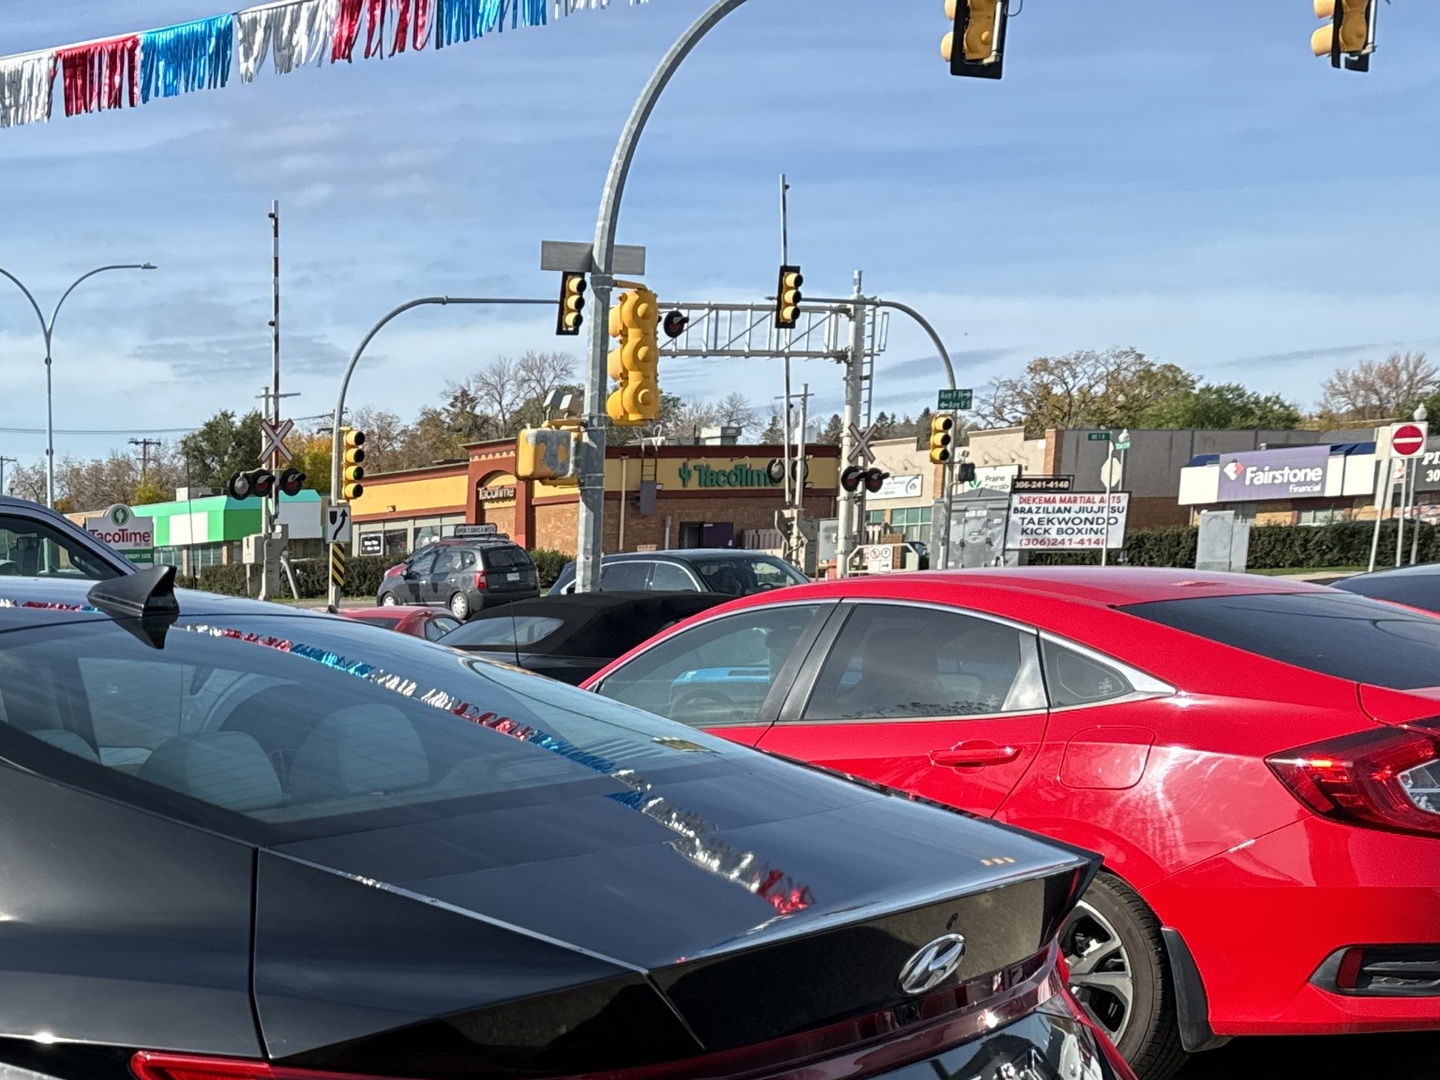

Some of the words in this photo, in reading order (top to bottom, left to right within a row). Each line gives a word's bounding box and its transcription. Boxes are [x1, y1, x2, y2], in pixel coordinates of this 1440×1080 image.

[694, 463, 779, 488] TacoTim
[1245, 465, 1323, 486] Fairstone
[1014, 480, 1069, 489] 306-241-4148
[1288, 482, 1322, 493] Financial
[1018, 496, 1057, 505] DIEKEMA
[1059, 496, 1097, 504] MARTIAL
[1098, 495, 1121, 504] ATS
[1012, 506, 1072, 515] BRAZILIAN
[1018, 516, 1119, 526] TAEKWONDO
[1021, 527, 1052, 536] KICK
